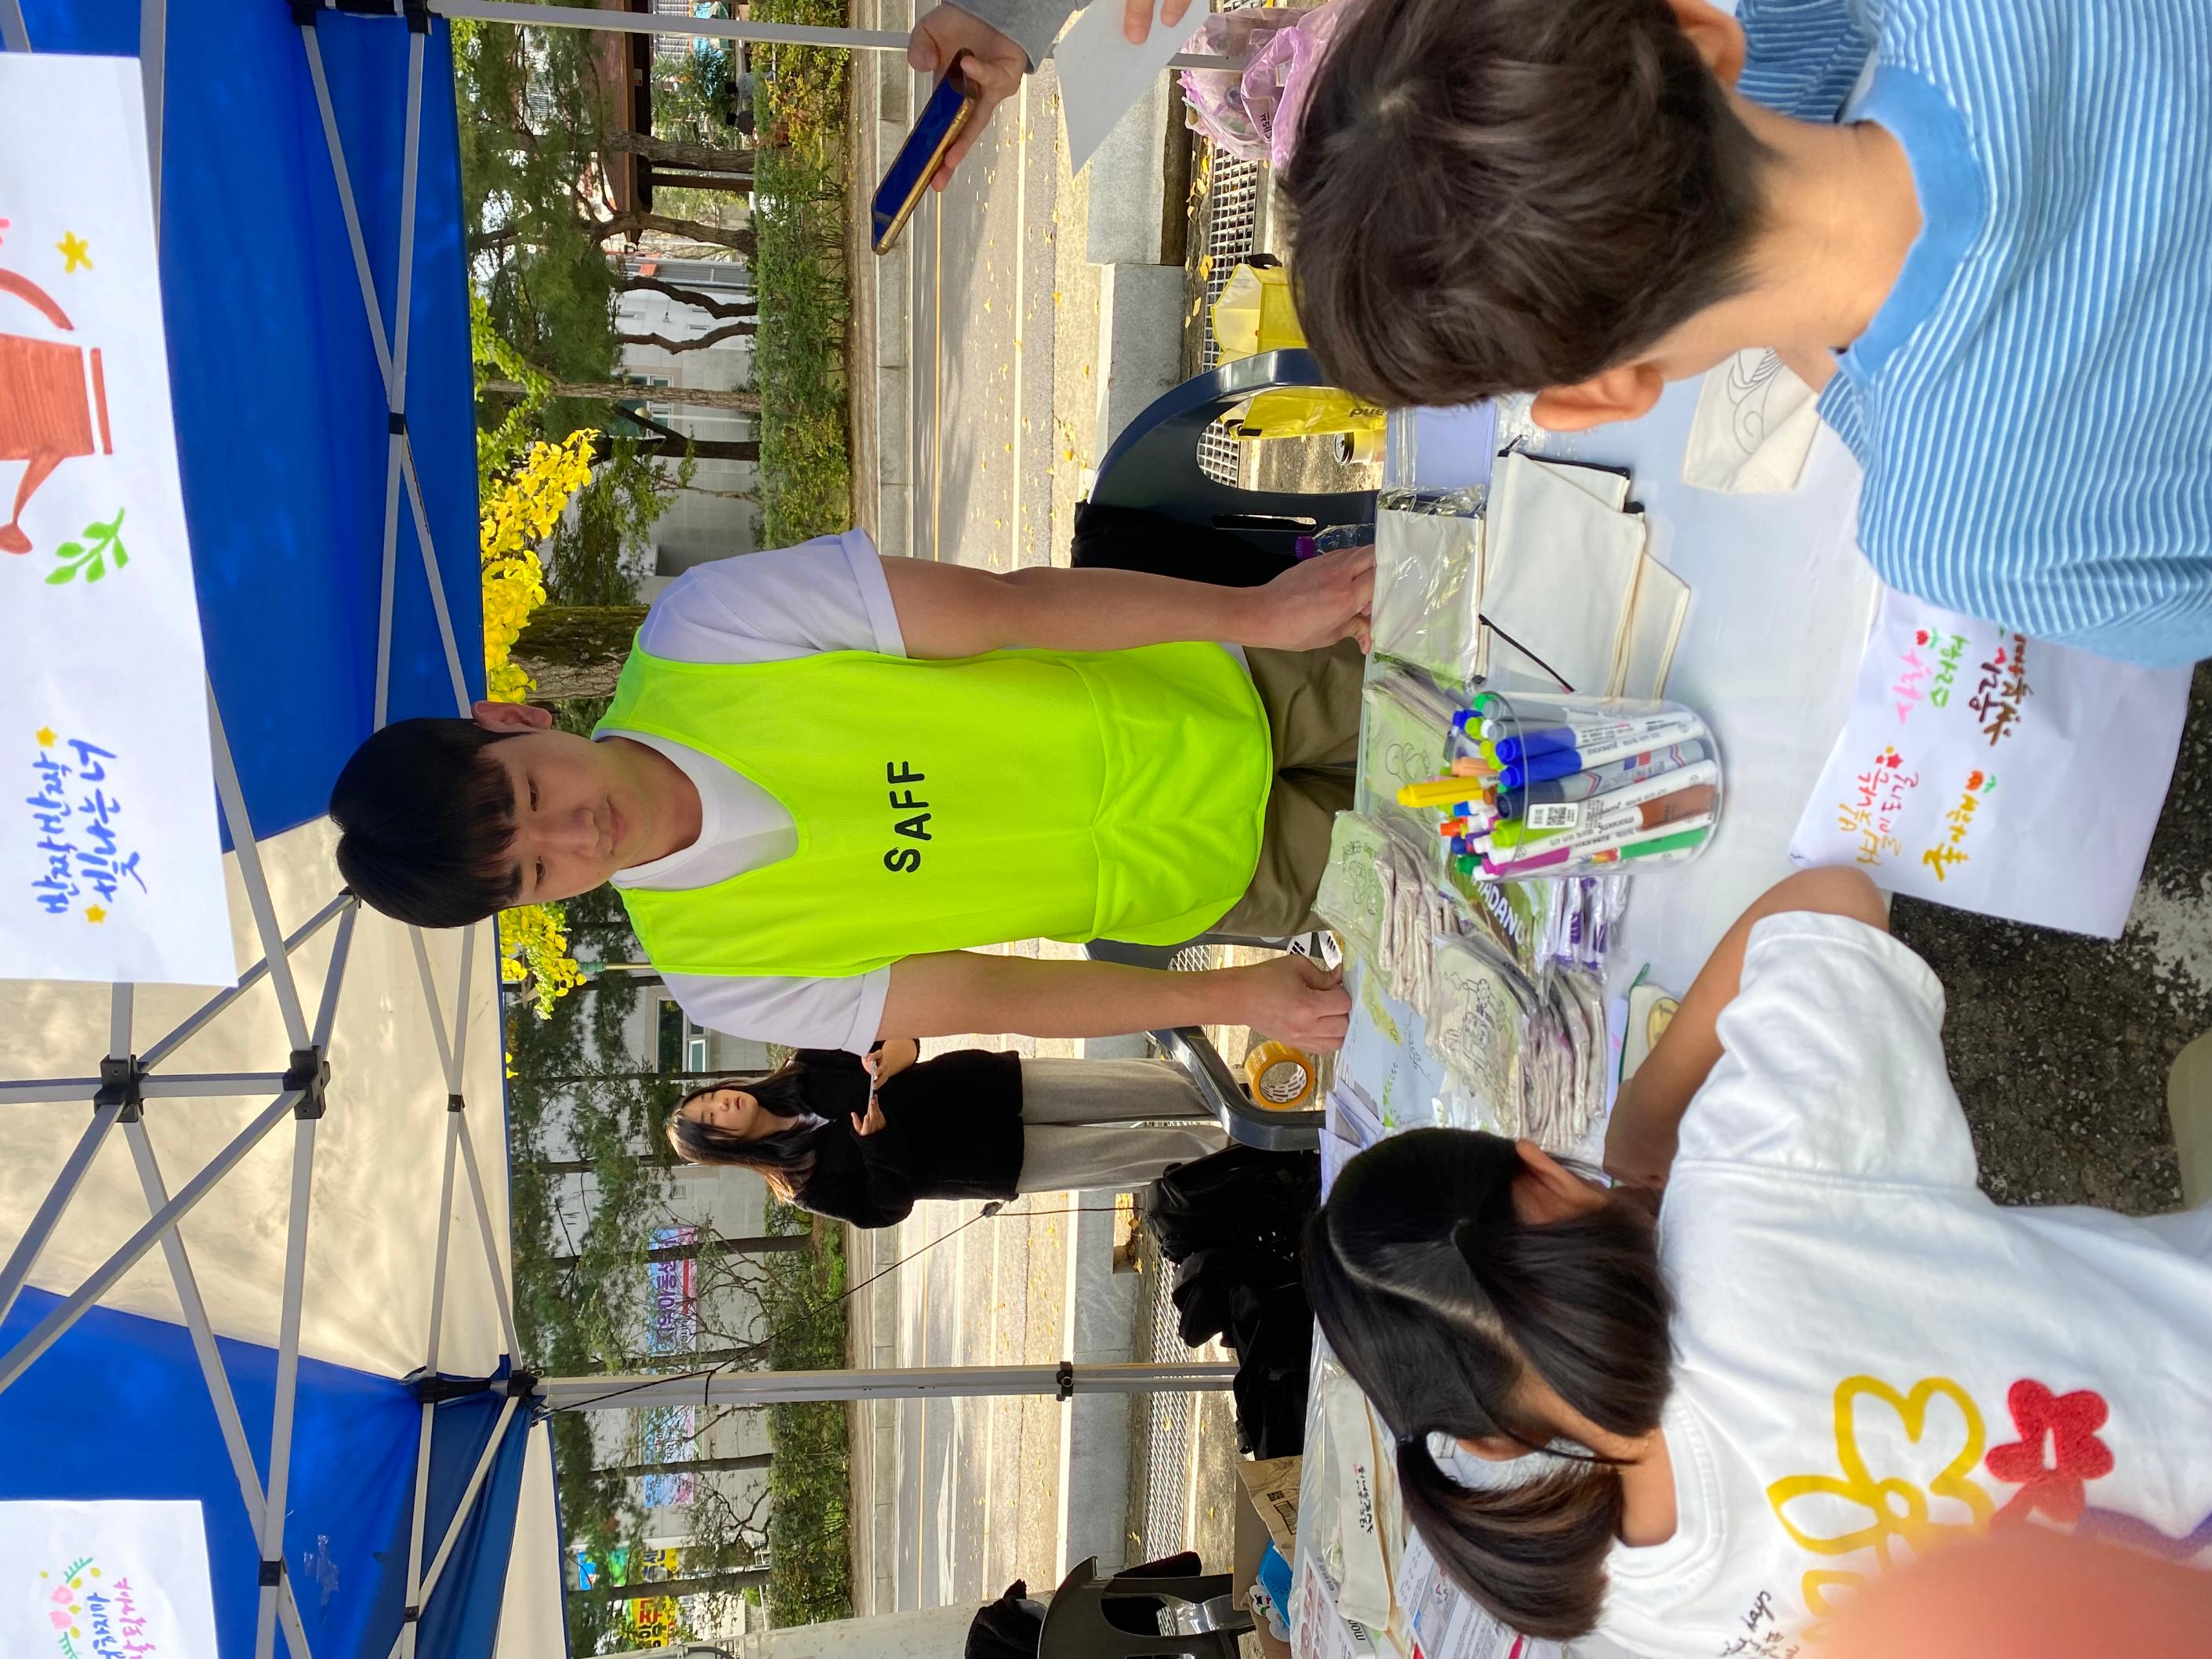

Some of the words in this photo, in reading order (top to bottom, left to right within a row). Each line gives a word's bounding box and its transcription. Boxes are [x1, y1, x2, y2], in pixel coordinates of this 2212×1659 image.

[1891, 648, 1933, 724] 사랑
[1930, 634, 1971, 708] 스러워
[1968, 662, 2003, 723] 우리
[67, 739, 118, 782] 너
[883, 761, 931, 873] SAFF
[1838, 769, 1889, 831] 빛나는
[1922, 793, 1980, 882] 좋아해
[75, 788, 147, 903] 빛나는
